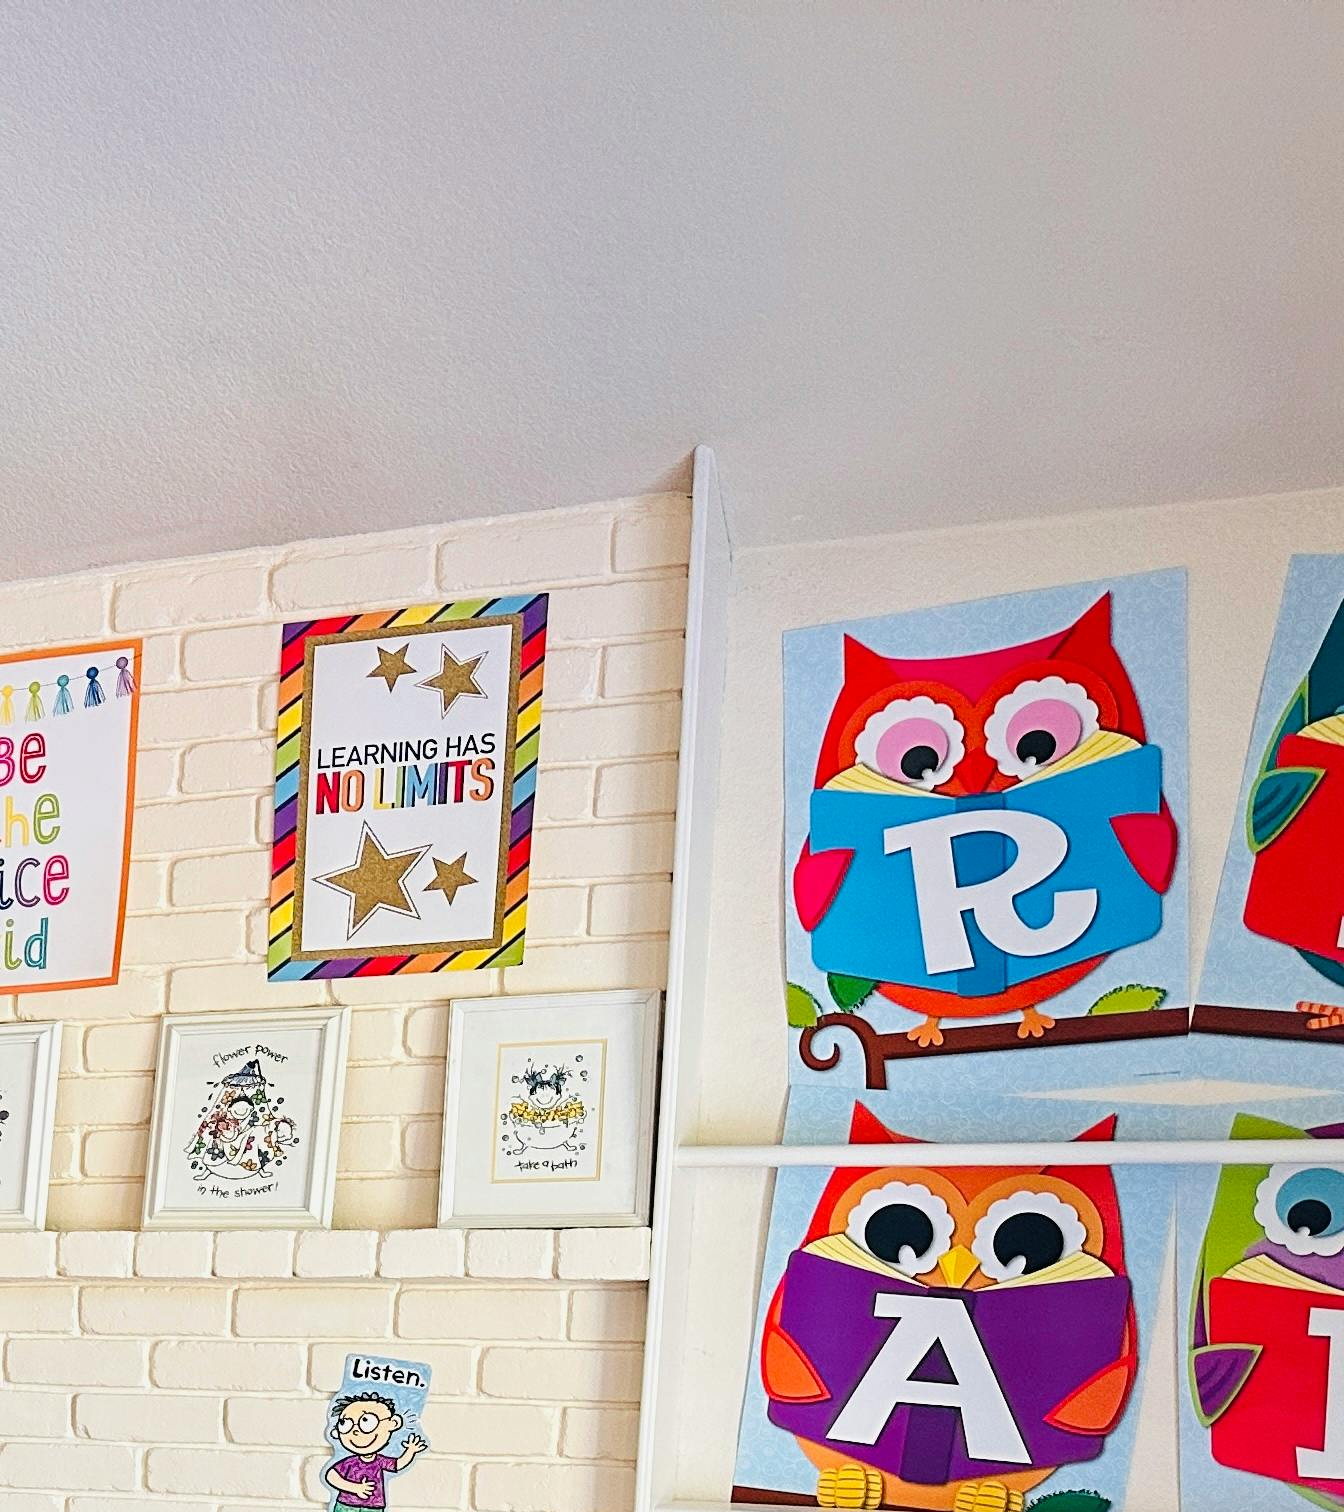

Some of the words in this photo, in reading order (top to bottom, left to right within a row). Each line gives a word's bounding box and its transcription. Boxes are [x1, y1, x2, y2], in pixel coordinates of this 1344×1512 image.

[317, 738, 438, 769] LEARNING
[445, 733, 496, 758] HAS
[315, 769, 366, 815] NO
[373, 757, 496, 810] LIMITS
[883, 809, 1098, 975] R
[212, 1044, 251, 1068] flower
[255, 1044, 288, 1064] power
[514, 1160, 540, 1172] take
[542, 1160, 550, 1168] a
[197, 1184, 207, 1196] in
[210, 1185, 230, 1199] the
[234, 1181, 279, 1199] shower!
[352, 1358, 425, 1388] Listen.
[825, 1292, 1033, 1464] A
